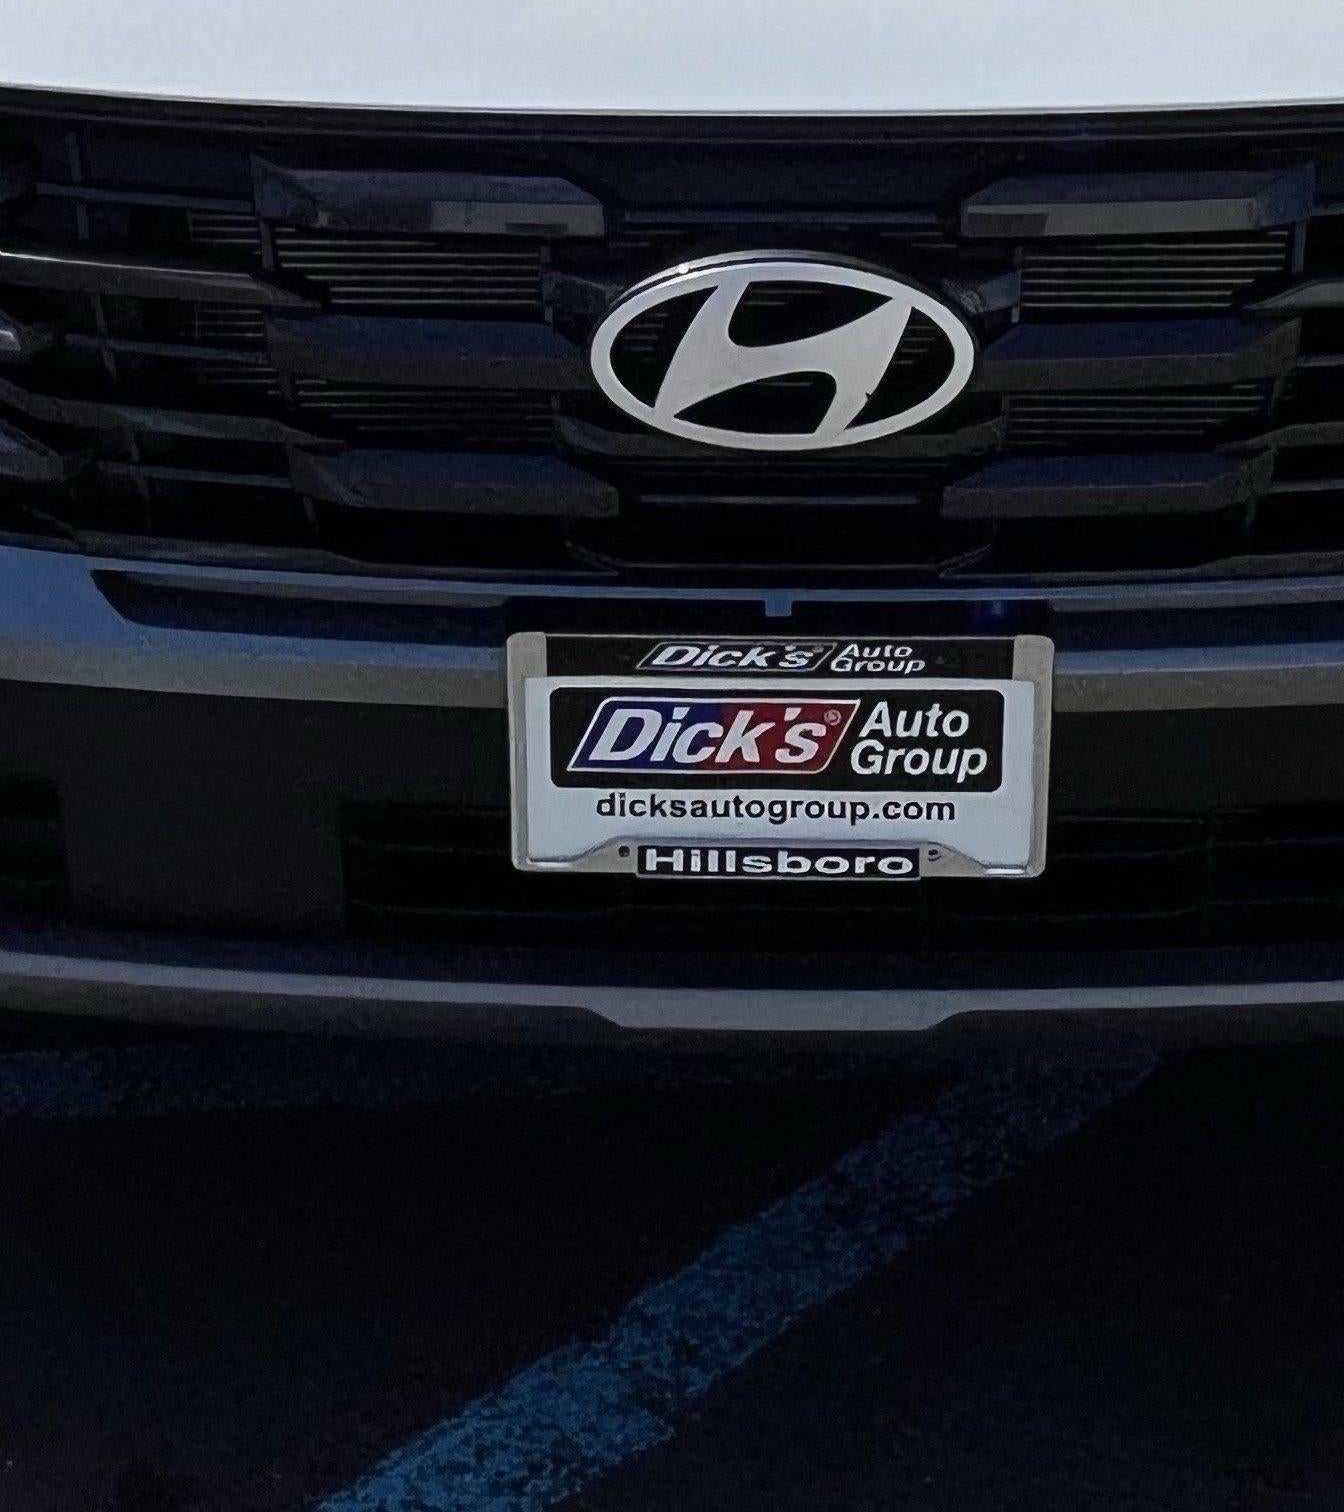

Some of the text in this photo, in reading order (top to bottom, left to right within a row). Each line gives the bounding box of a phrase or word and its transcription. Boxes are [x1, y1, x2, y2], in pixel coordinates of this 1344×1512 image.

[652, 644, 814, 668] Dick's
[830, 656, 926, 675] Group
[834, 643, 913, 658] Auto
[588, 707, 827, 763] Dick's
[859, 701, 970, 739] Auto
[850, 739, 988, 784] Group
[596, 792, 956, 826] dicksautogroup.com
[645, 848, 914, 875] Hillsboro
